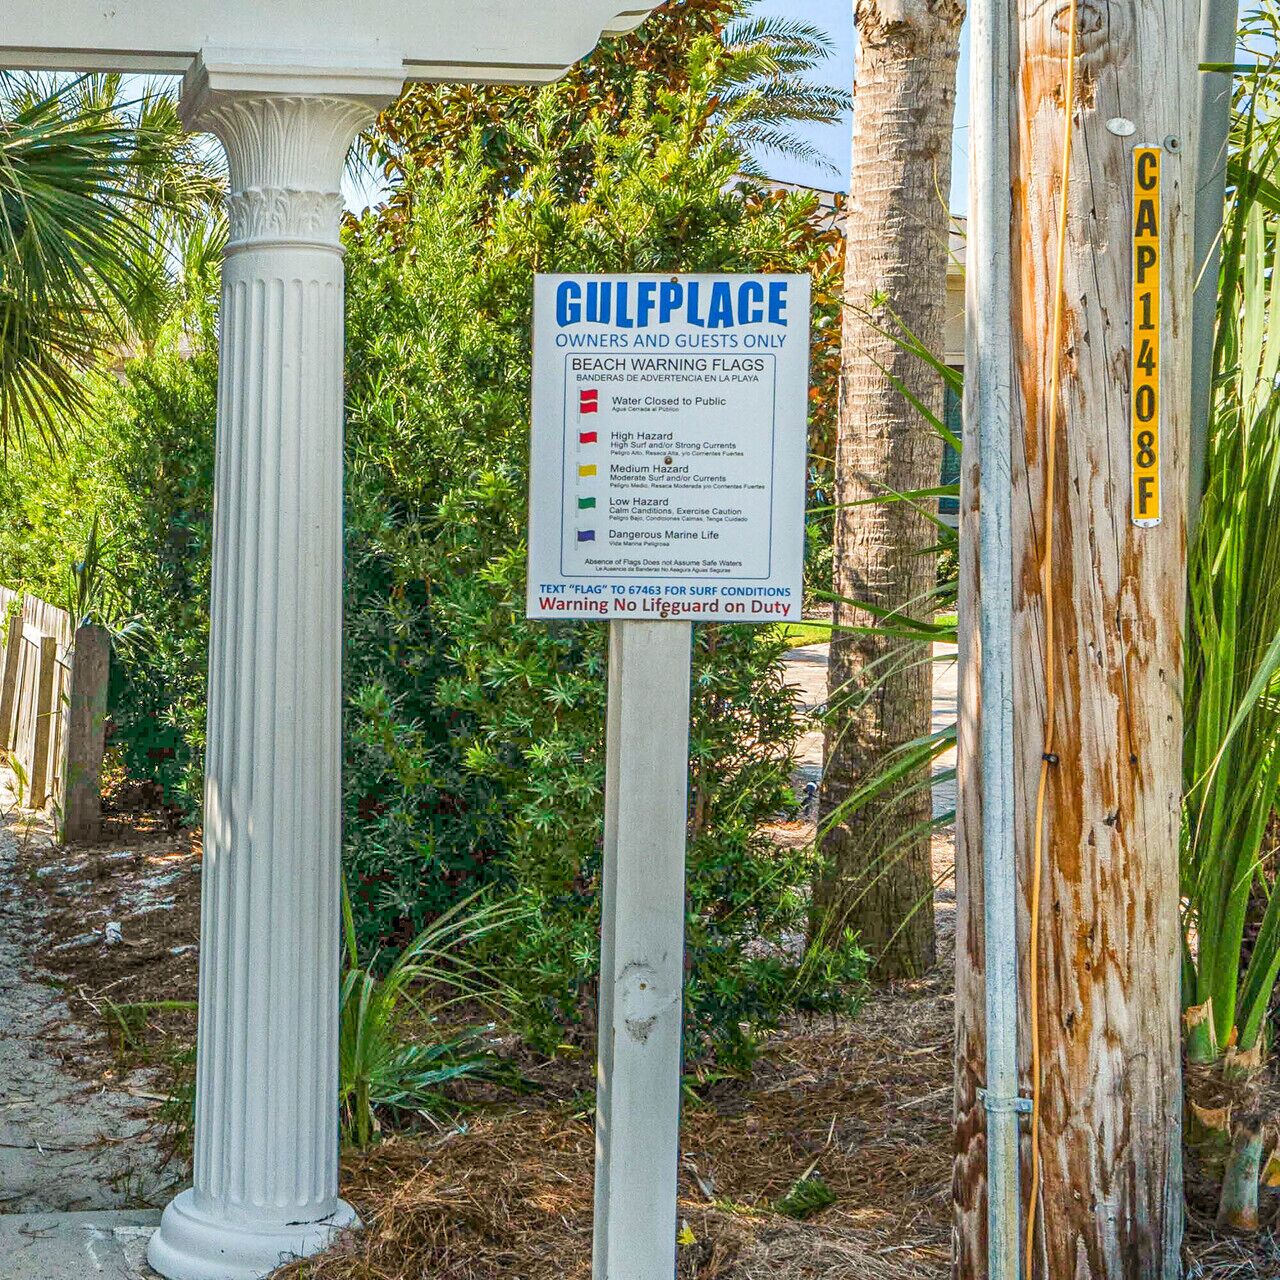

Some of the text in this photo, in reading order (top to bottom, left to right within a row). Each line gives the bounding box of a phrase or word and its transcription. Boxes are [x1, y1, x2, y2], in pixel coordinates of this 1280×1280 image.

[556, 280, 788, 329] GULFPLACE
[1134, 151, 1158, 515] CAP1408F
[556, 333, 787, 348] OWNERS AND GUESTS ONLY
[572, 358, 764, 372] BEACH WARNING FLAGS
[576, 374, 624, 382] BANDERAS
[627, 374, 638, 382] DE
[640, 374, 703, 382] ADVERTENCIA
[704, 374, 717, 382] EN
[718, 374, 732, 382] LA
[612, 397, 726, 406] Water Closed to Public
[611, 432, 673, 442] High Hazard
[611, 442, 628, 450] High
[676, 442, 700, 450] Strong
[610, 464, 689, 473] Medium Hazard
[609, 498, 669, 506] Low Hazard
[609, 530, 719, 540] Dangerous Marine Life
[623, 559, 641, 567] Flags
[540, 585, 566, 594] TEXT
[611, 585, 626, 595] TO
[628, 585, 661, 595] 67463
[665, 586, 686, 595] FOR
[689, 586, 718, 596] SURF
[721, 587, 791, 597] CONDITIONS
[539, 597, 791, 616] Warning No Lifeguard on Duty
